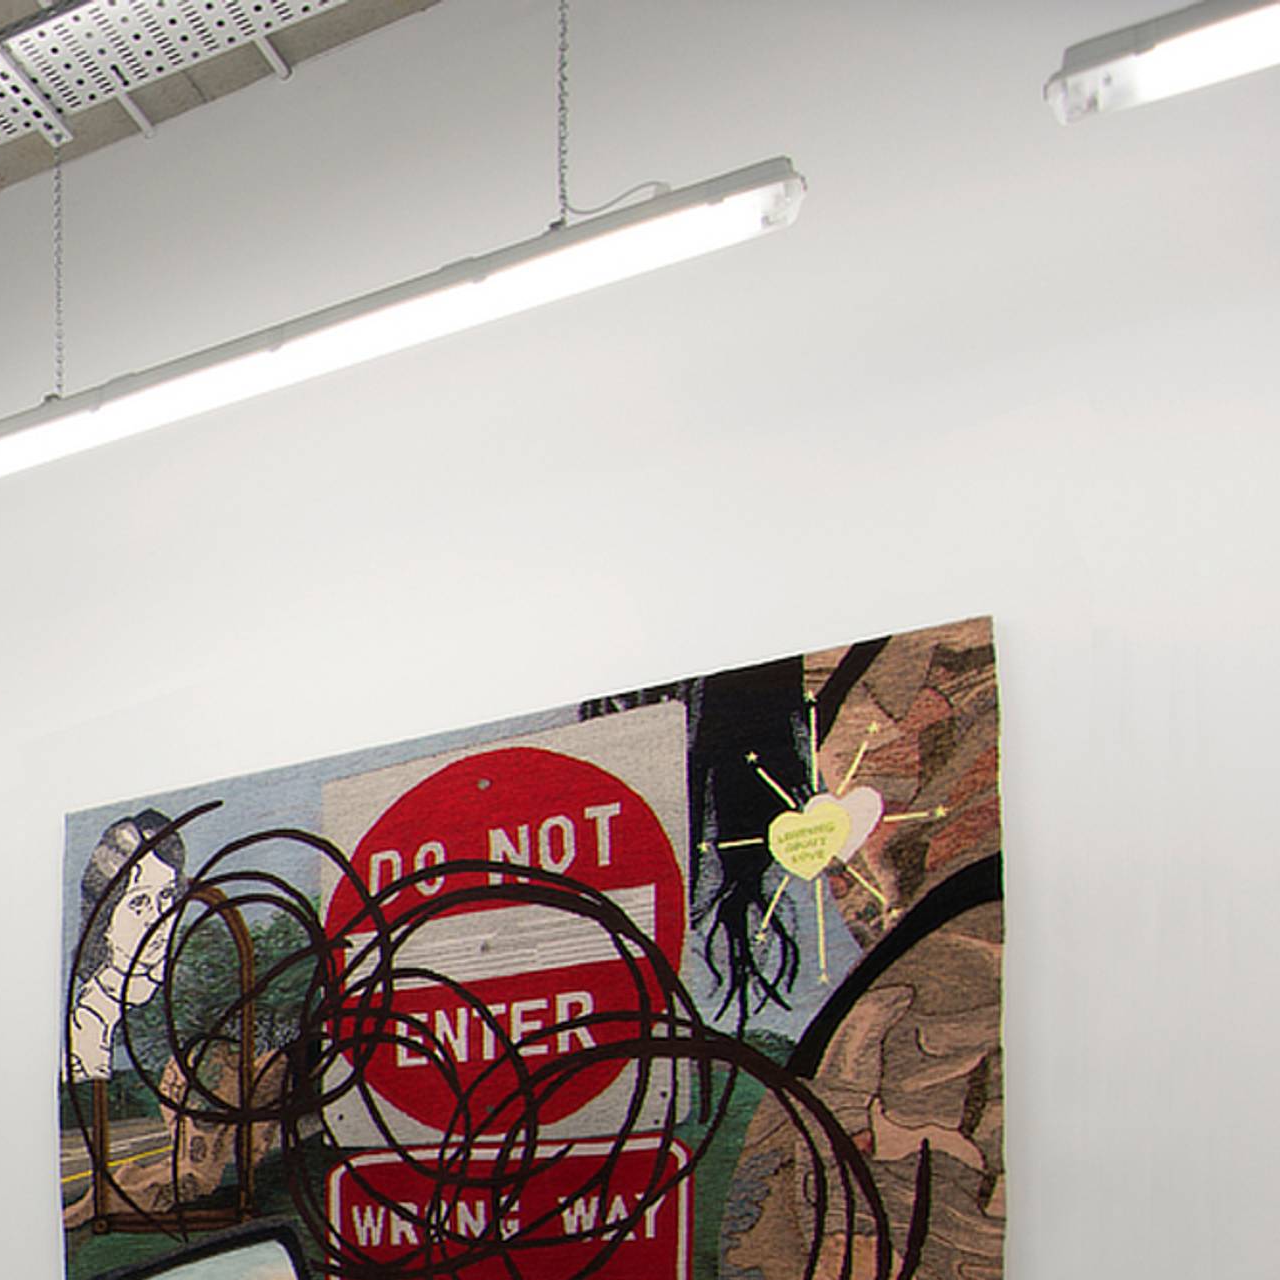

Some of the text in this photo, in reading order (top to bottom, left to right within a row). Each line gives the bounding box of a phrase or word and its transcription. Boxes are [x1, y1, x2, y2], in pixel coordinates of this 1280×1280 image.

[369, 803, 621, 904] DO NOT
[395, 991, 598, 1068] ENTER
